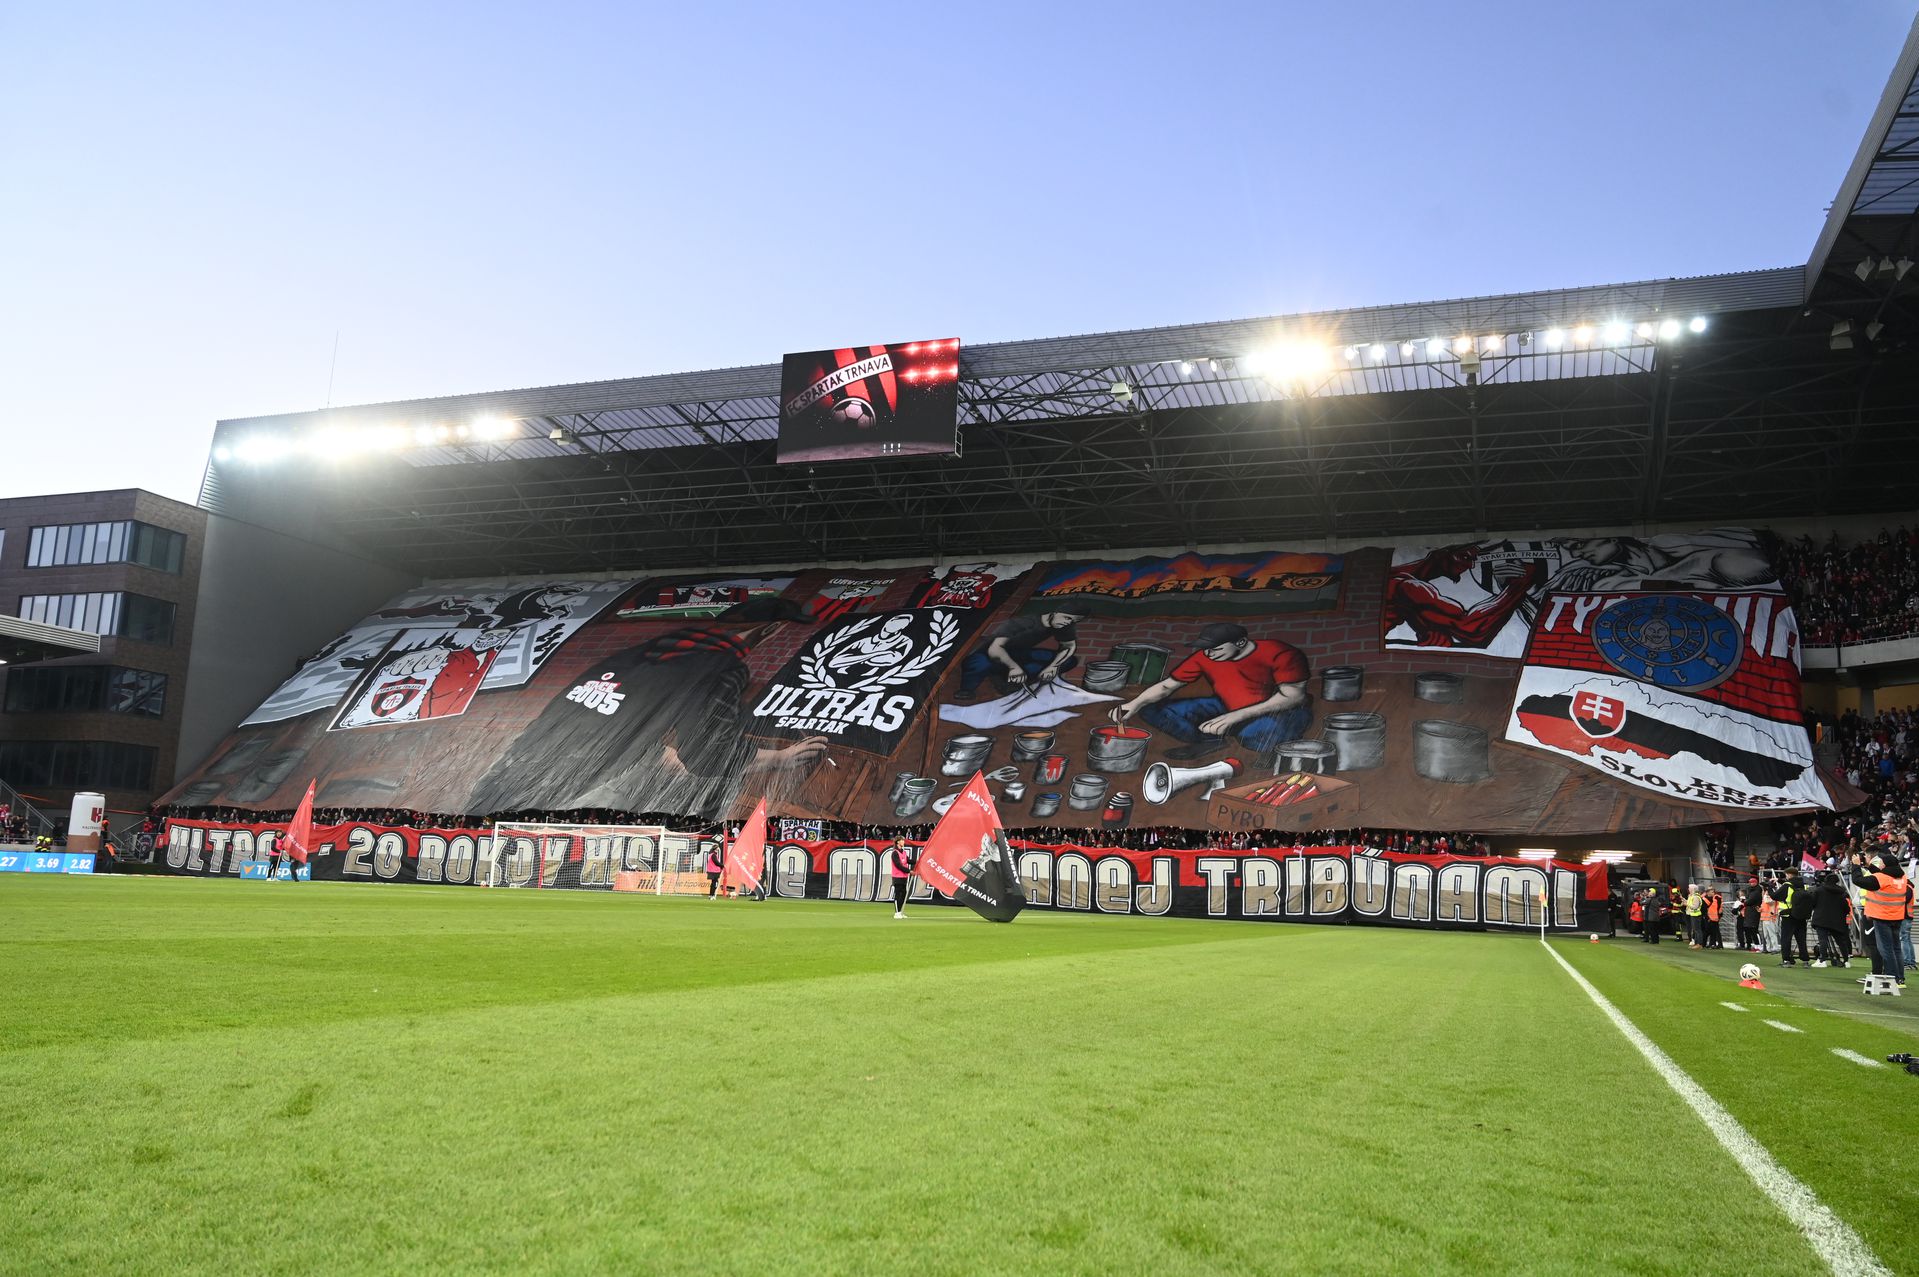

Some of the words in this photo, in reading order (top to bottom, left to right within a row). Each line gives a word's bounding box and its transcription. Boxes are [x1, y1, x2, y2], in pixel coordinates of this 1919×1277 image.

[788, 401, 802, 416] FC
[801, 372, 844, 406] SPARTAK
[845, 356, 890, 380] TRNAVA
[566, 686, 626, 715] 2005
[753, 684, 914, 732] ULTRAS
[775, 716, 849, 734] SPARTAK
[1217, 805, 1264, 828] PYRO
[36, 858, 59, 868] 3.69
[70, 859, 92, 870] 2.82
[342, 826, 401, 880] 20
[927, 857, 937, 869] FC
[935, 865, 966, 891] SPARTAK
[967, 885, 997, 907] TRNAVA
